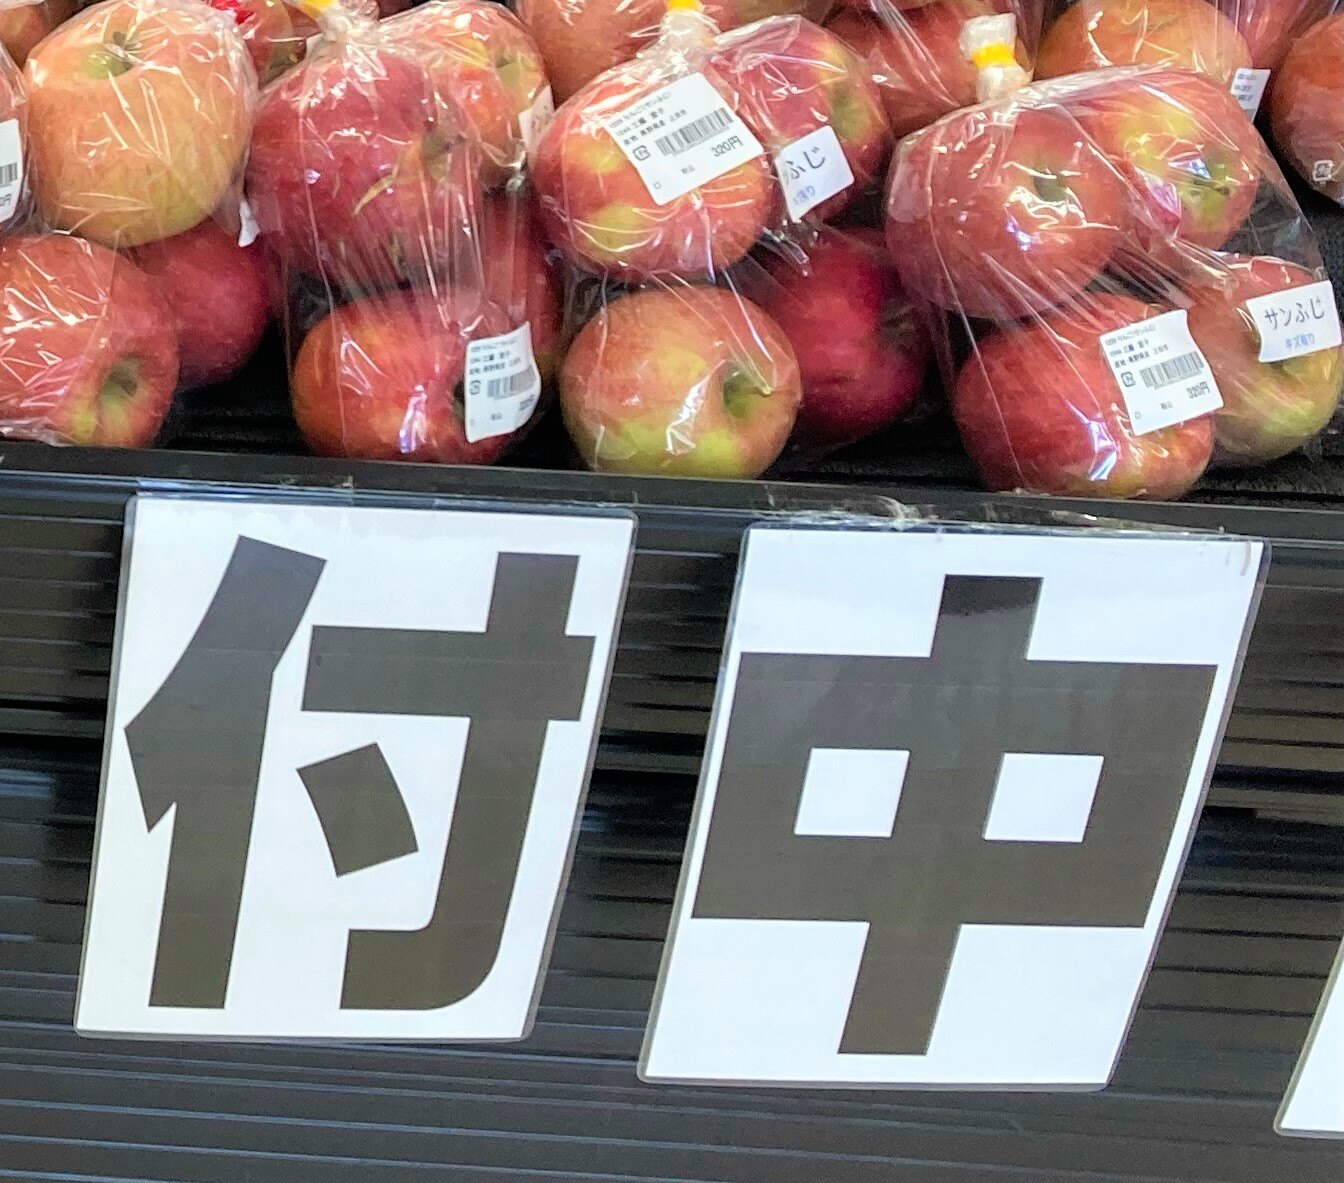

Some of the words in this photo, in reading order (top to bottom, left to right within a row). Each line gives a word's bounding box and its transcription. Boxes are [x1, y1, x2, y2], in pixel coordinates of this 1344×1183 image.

[708, 134, 745, 159] 320円
[1263, 296, 1326, 331] サンふじ
[1185, 381, 1211, 401] 320円
